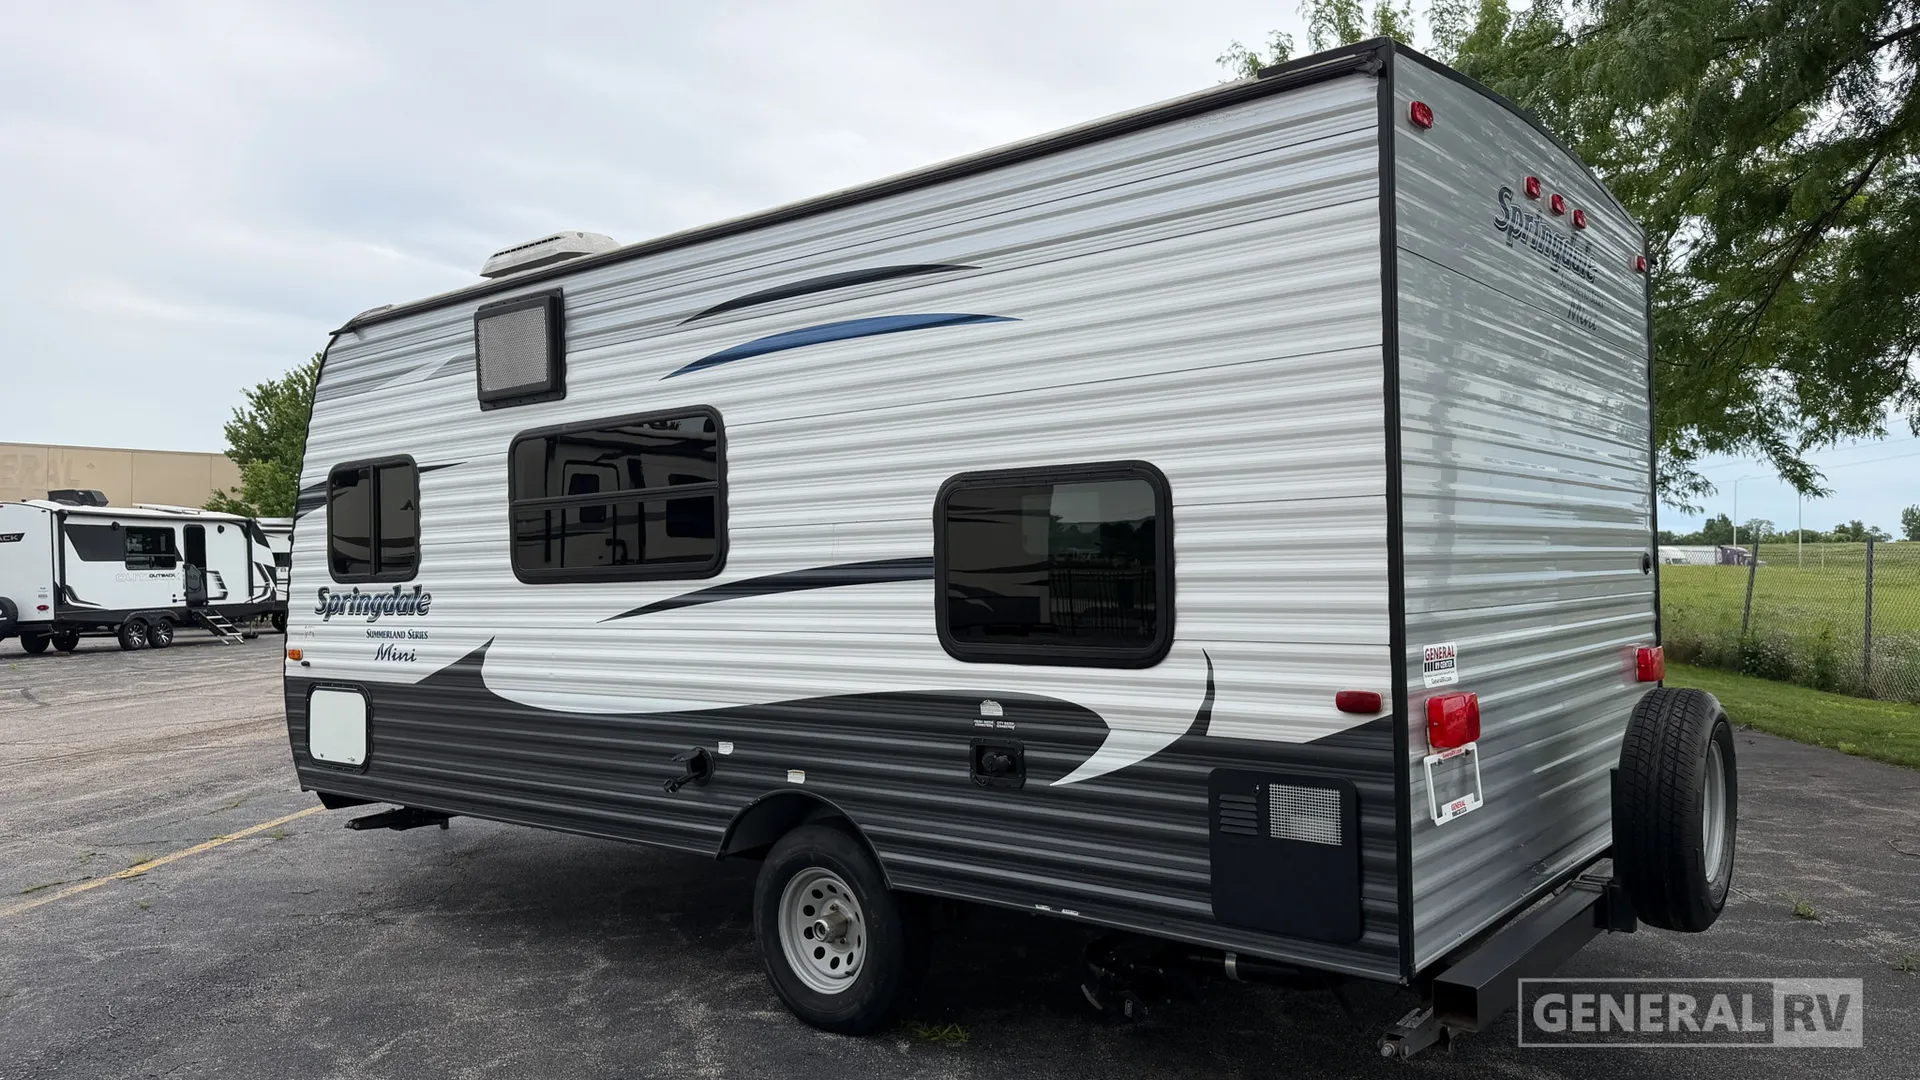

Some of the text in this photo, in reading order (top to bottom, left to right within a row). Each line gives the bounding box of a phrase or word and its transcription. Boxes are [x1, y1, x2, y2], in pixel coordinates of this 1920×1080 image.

[1493, 186, 1597, 283] Springdale
[314, 584, 432, 623] Springdale
[407, 628, 429, 640] SERIES
[374, 643, 417, 662] Mini
[1425, 645, 1454, 660] GENERAL
